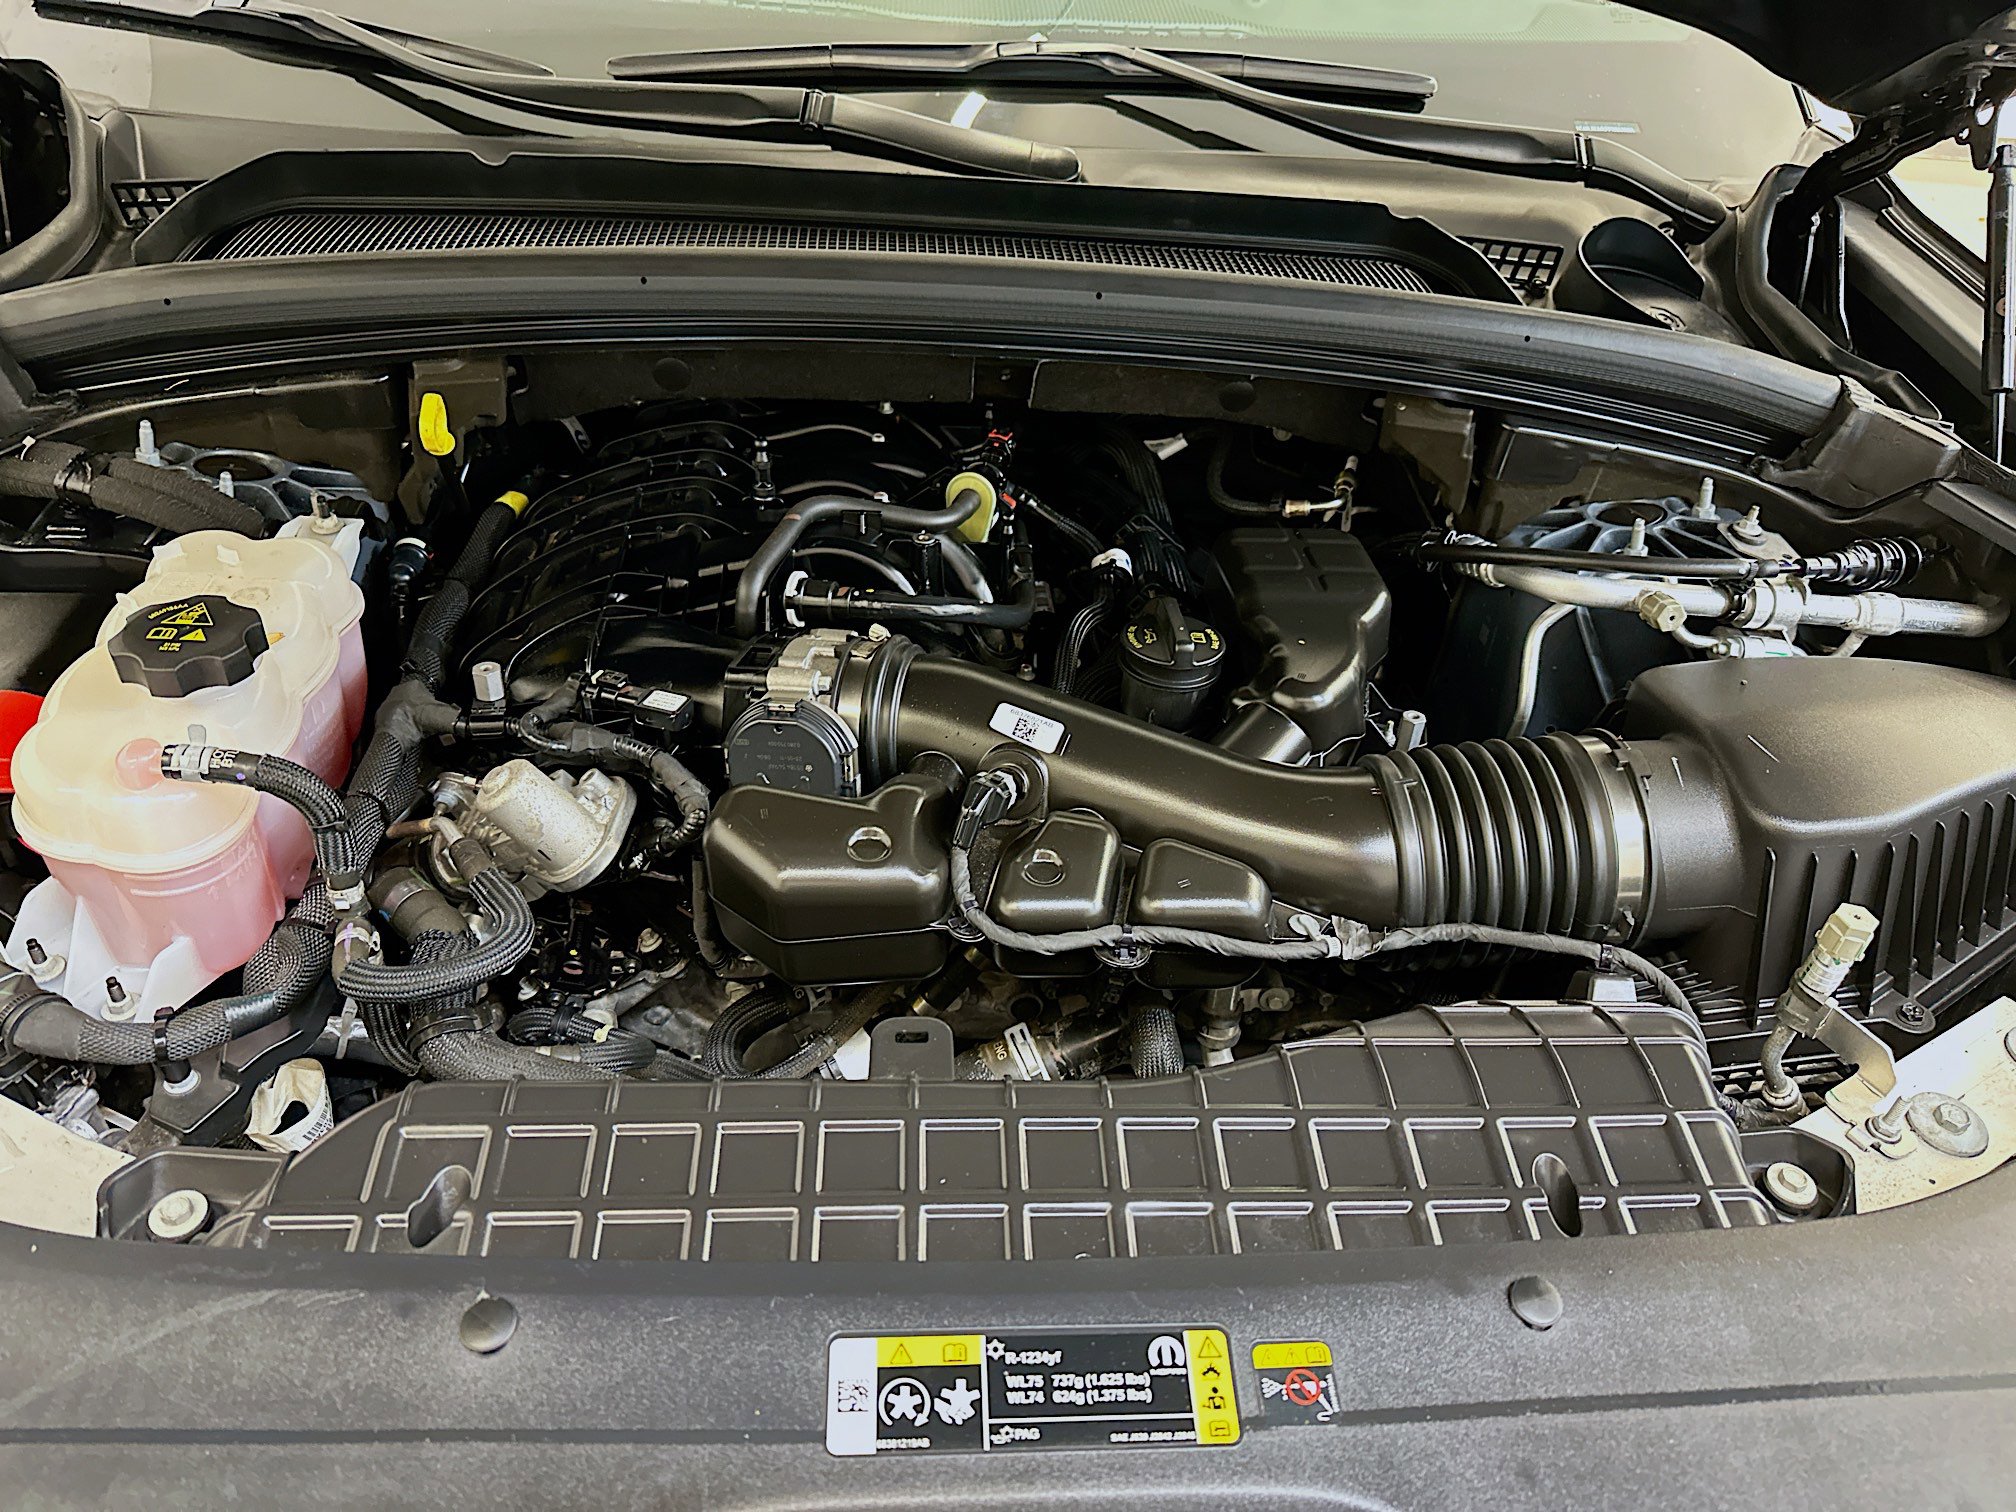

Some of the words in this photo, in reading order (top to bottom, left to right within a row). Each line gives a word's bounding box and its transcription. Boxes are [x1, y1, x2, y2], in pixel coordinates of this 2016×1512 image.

[993, 1042, 1008, 1061] ENG
[1005, 1351, 1062, 1366] R-1234yf
[1006, 1375, 1044, 1388] WL75
[1051, 1374, 1084, 1389] 737g
[1125, 1371, 1151, 1387] lbs)
[1006, 1391, 1045, 1404] WL74
[1052, 1390, 1085, 1405] 624g
[1087, 1389, 1125, 1404] (1.375
[1126, 1388, 1153, 1403] lbs)
[1014, 1428, 1040, 1440] PAG
